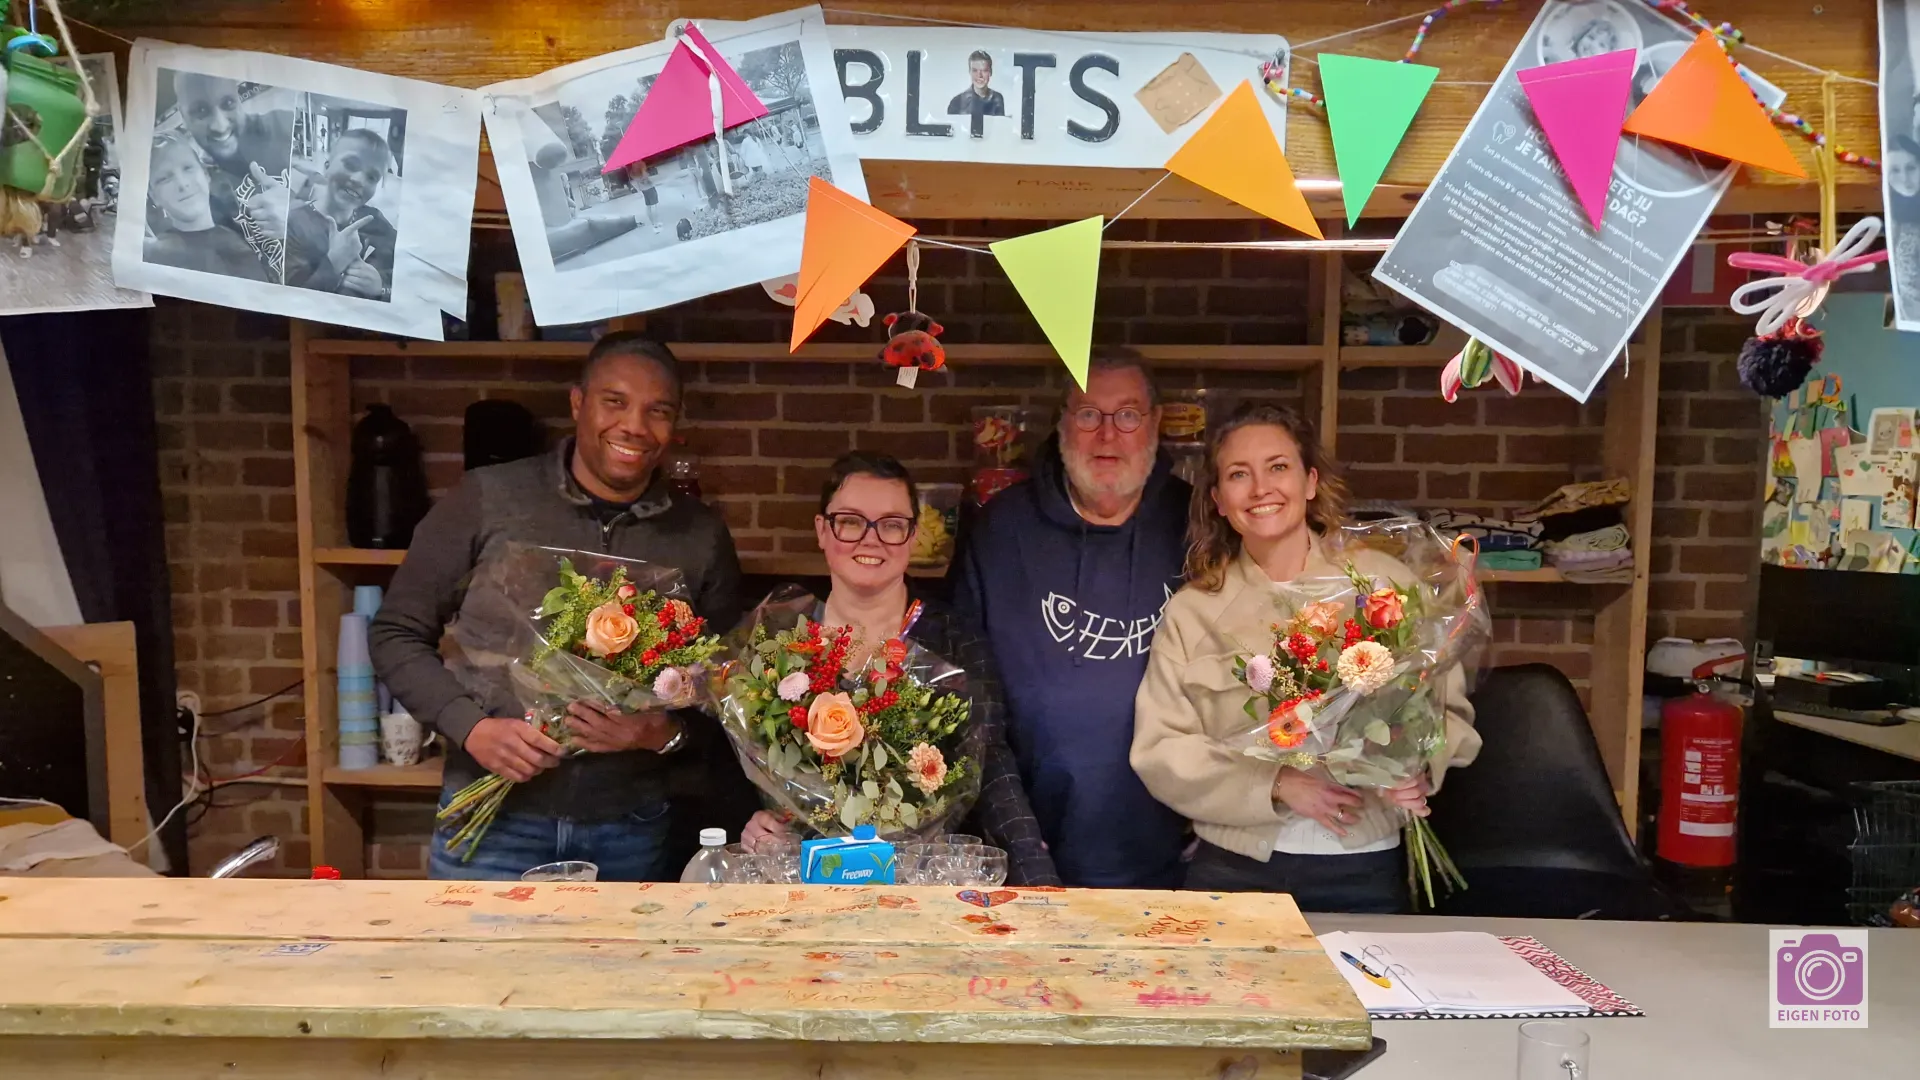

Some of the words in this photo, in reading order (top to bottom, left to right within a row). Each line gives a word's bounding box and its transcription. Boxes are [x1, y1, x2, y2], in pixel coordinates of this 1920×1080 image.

[834, 49, 1121, 143] BLTS
[1466, 158, 1484, 173] Poets
[1513, 137, 1534, 157] JE
[1606, 197, 1648, 229] DAG?
[1604, 175, 1636, 202] ETS
[1457, 201, 1473, 214] hard
[1491, 223, 1504, 234] het
[1464, 180, 1488, 200] Vergeet
[1487, 197, 1500, 208] niet
[1508, 210, 1541, 233] achterkant
[1541, 230, 1553, 240] van
[1447, 207, 1464, 221] Klaar
[1521, 254, 1534, 264] dan
[1584, 268, 1600, 281] hard
[841, 868, 874, 880] Freeway
